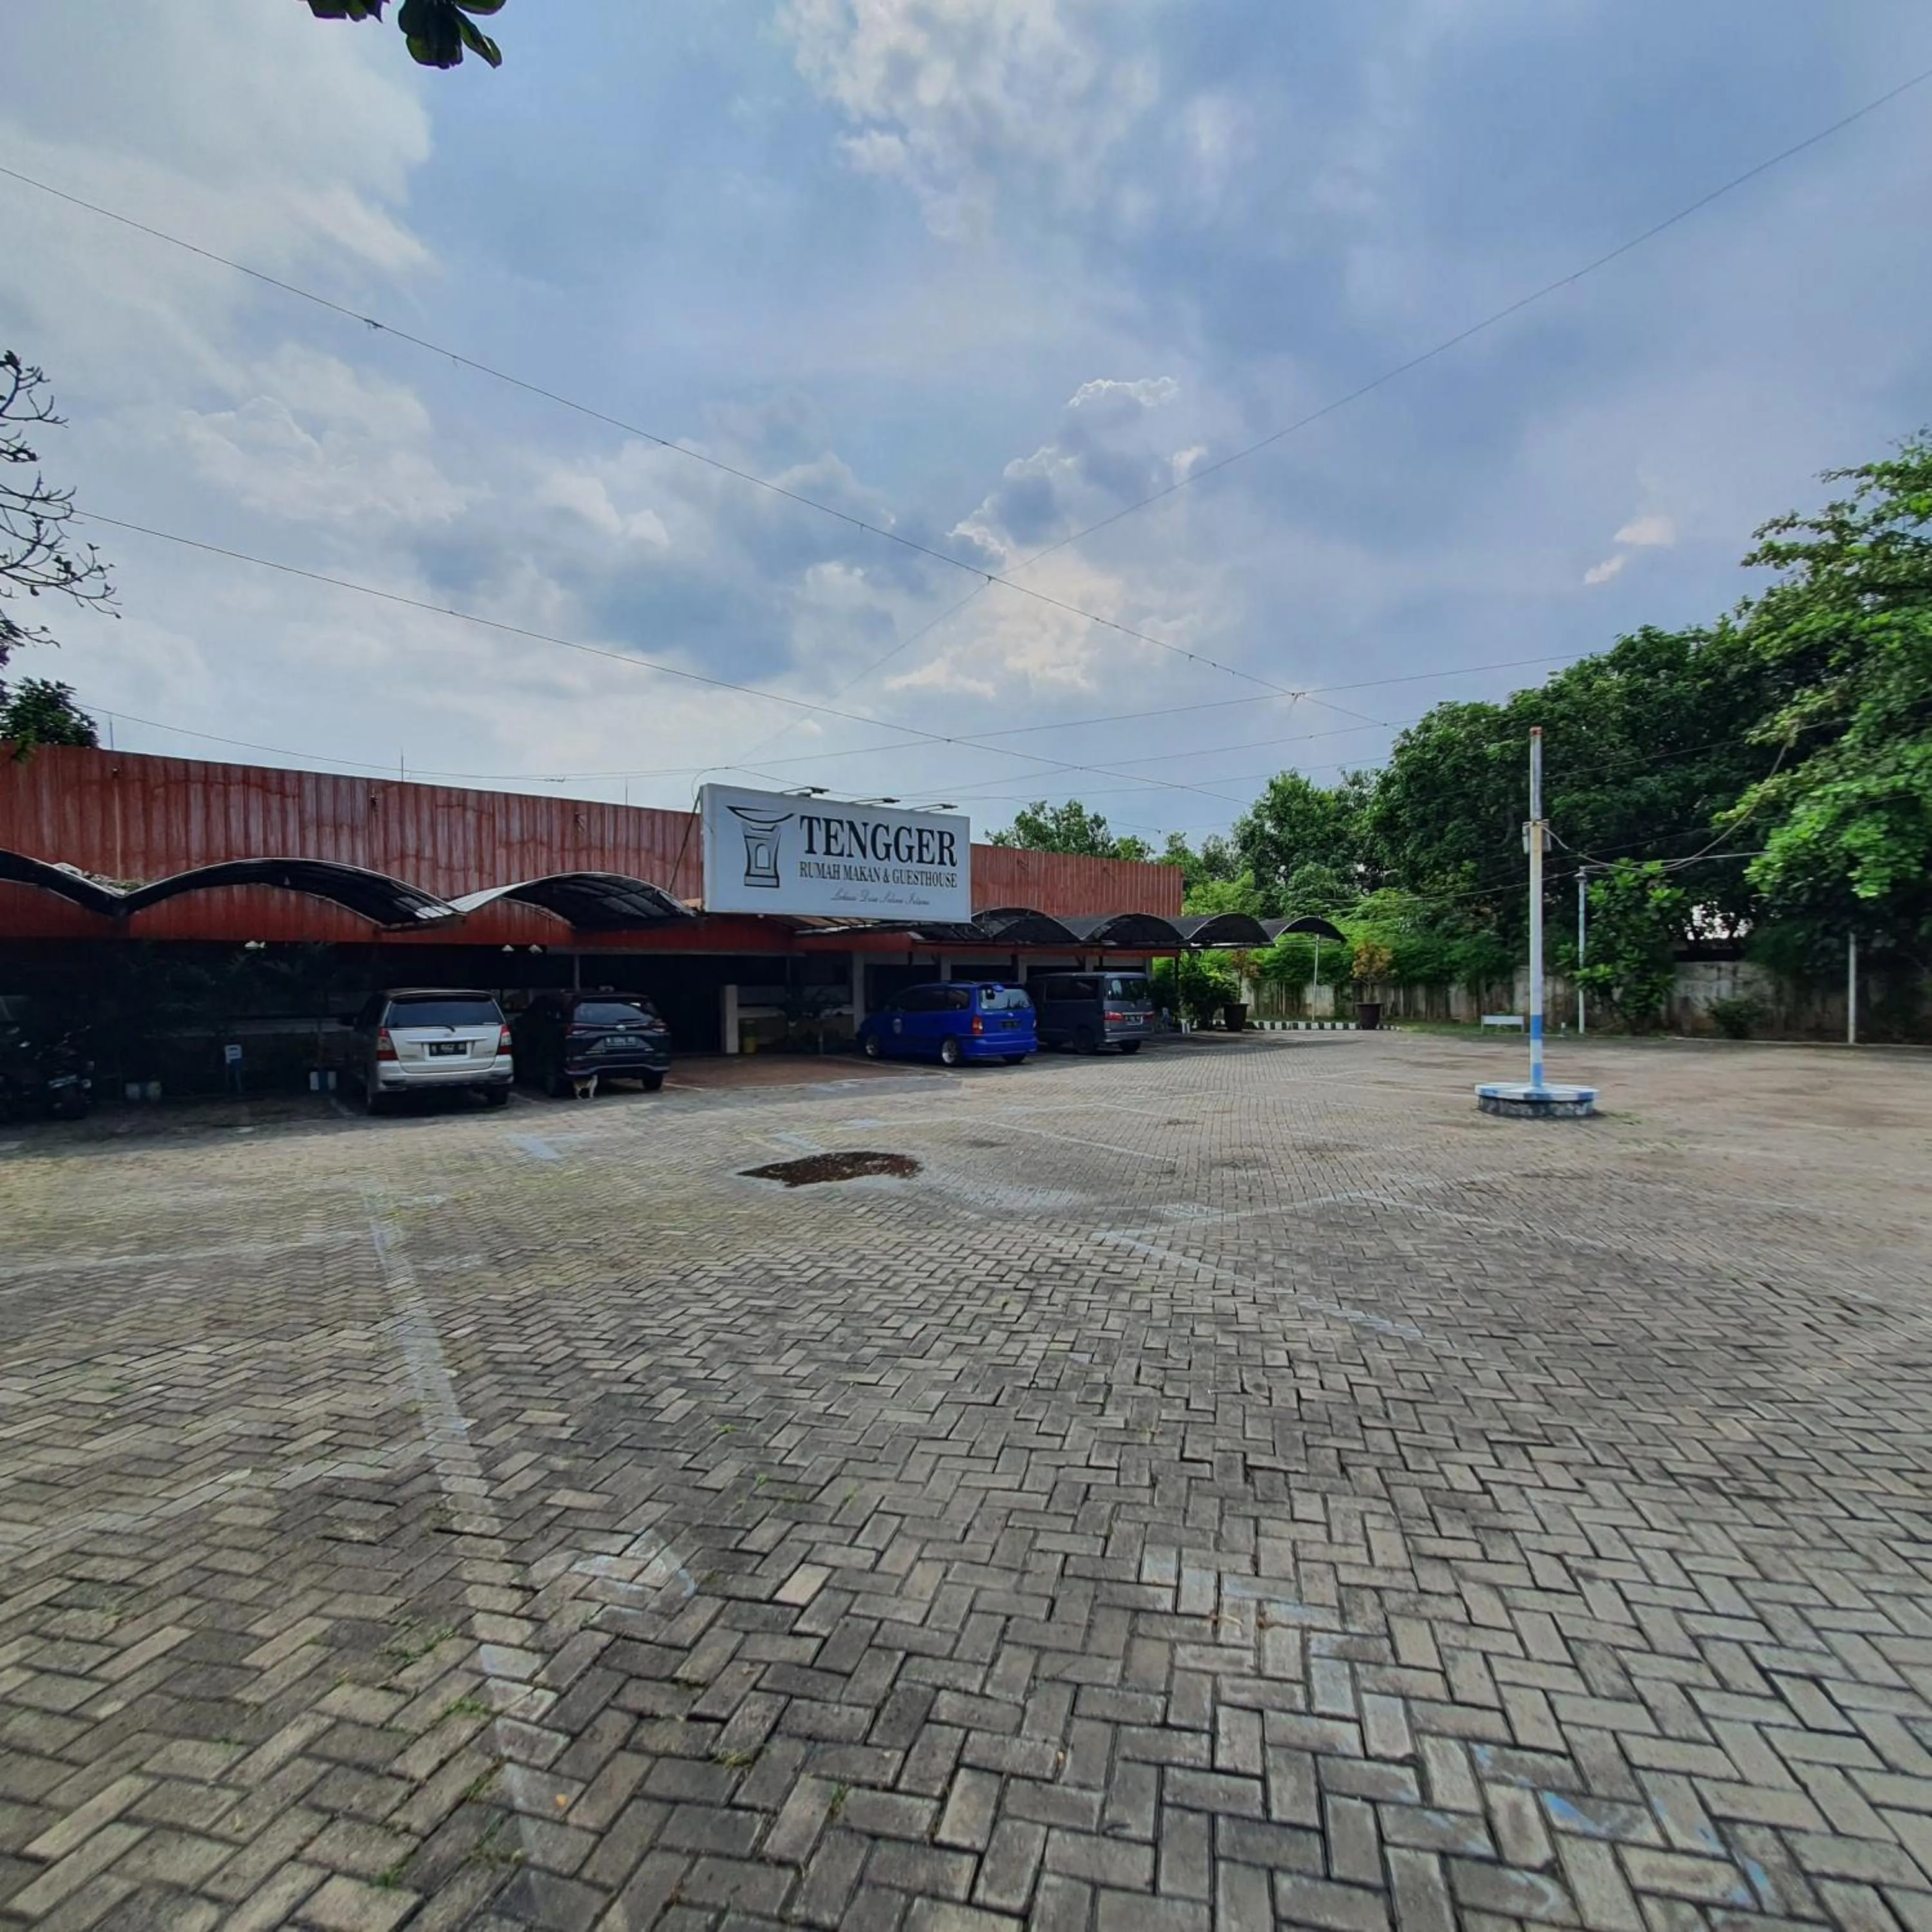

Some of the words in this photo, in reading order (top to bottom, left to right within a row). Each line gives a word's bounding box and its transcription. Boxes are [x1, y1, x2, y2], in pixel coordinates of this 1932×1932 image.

[799, 815, 958, 867] TENGGER
[799, 861, 840, 880] RUMAH
[843, 864, 881, 883] MAKAN
[883, 868, 890, 884] &
[892, 869, 958, 888] GUESTHOUSE
